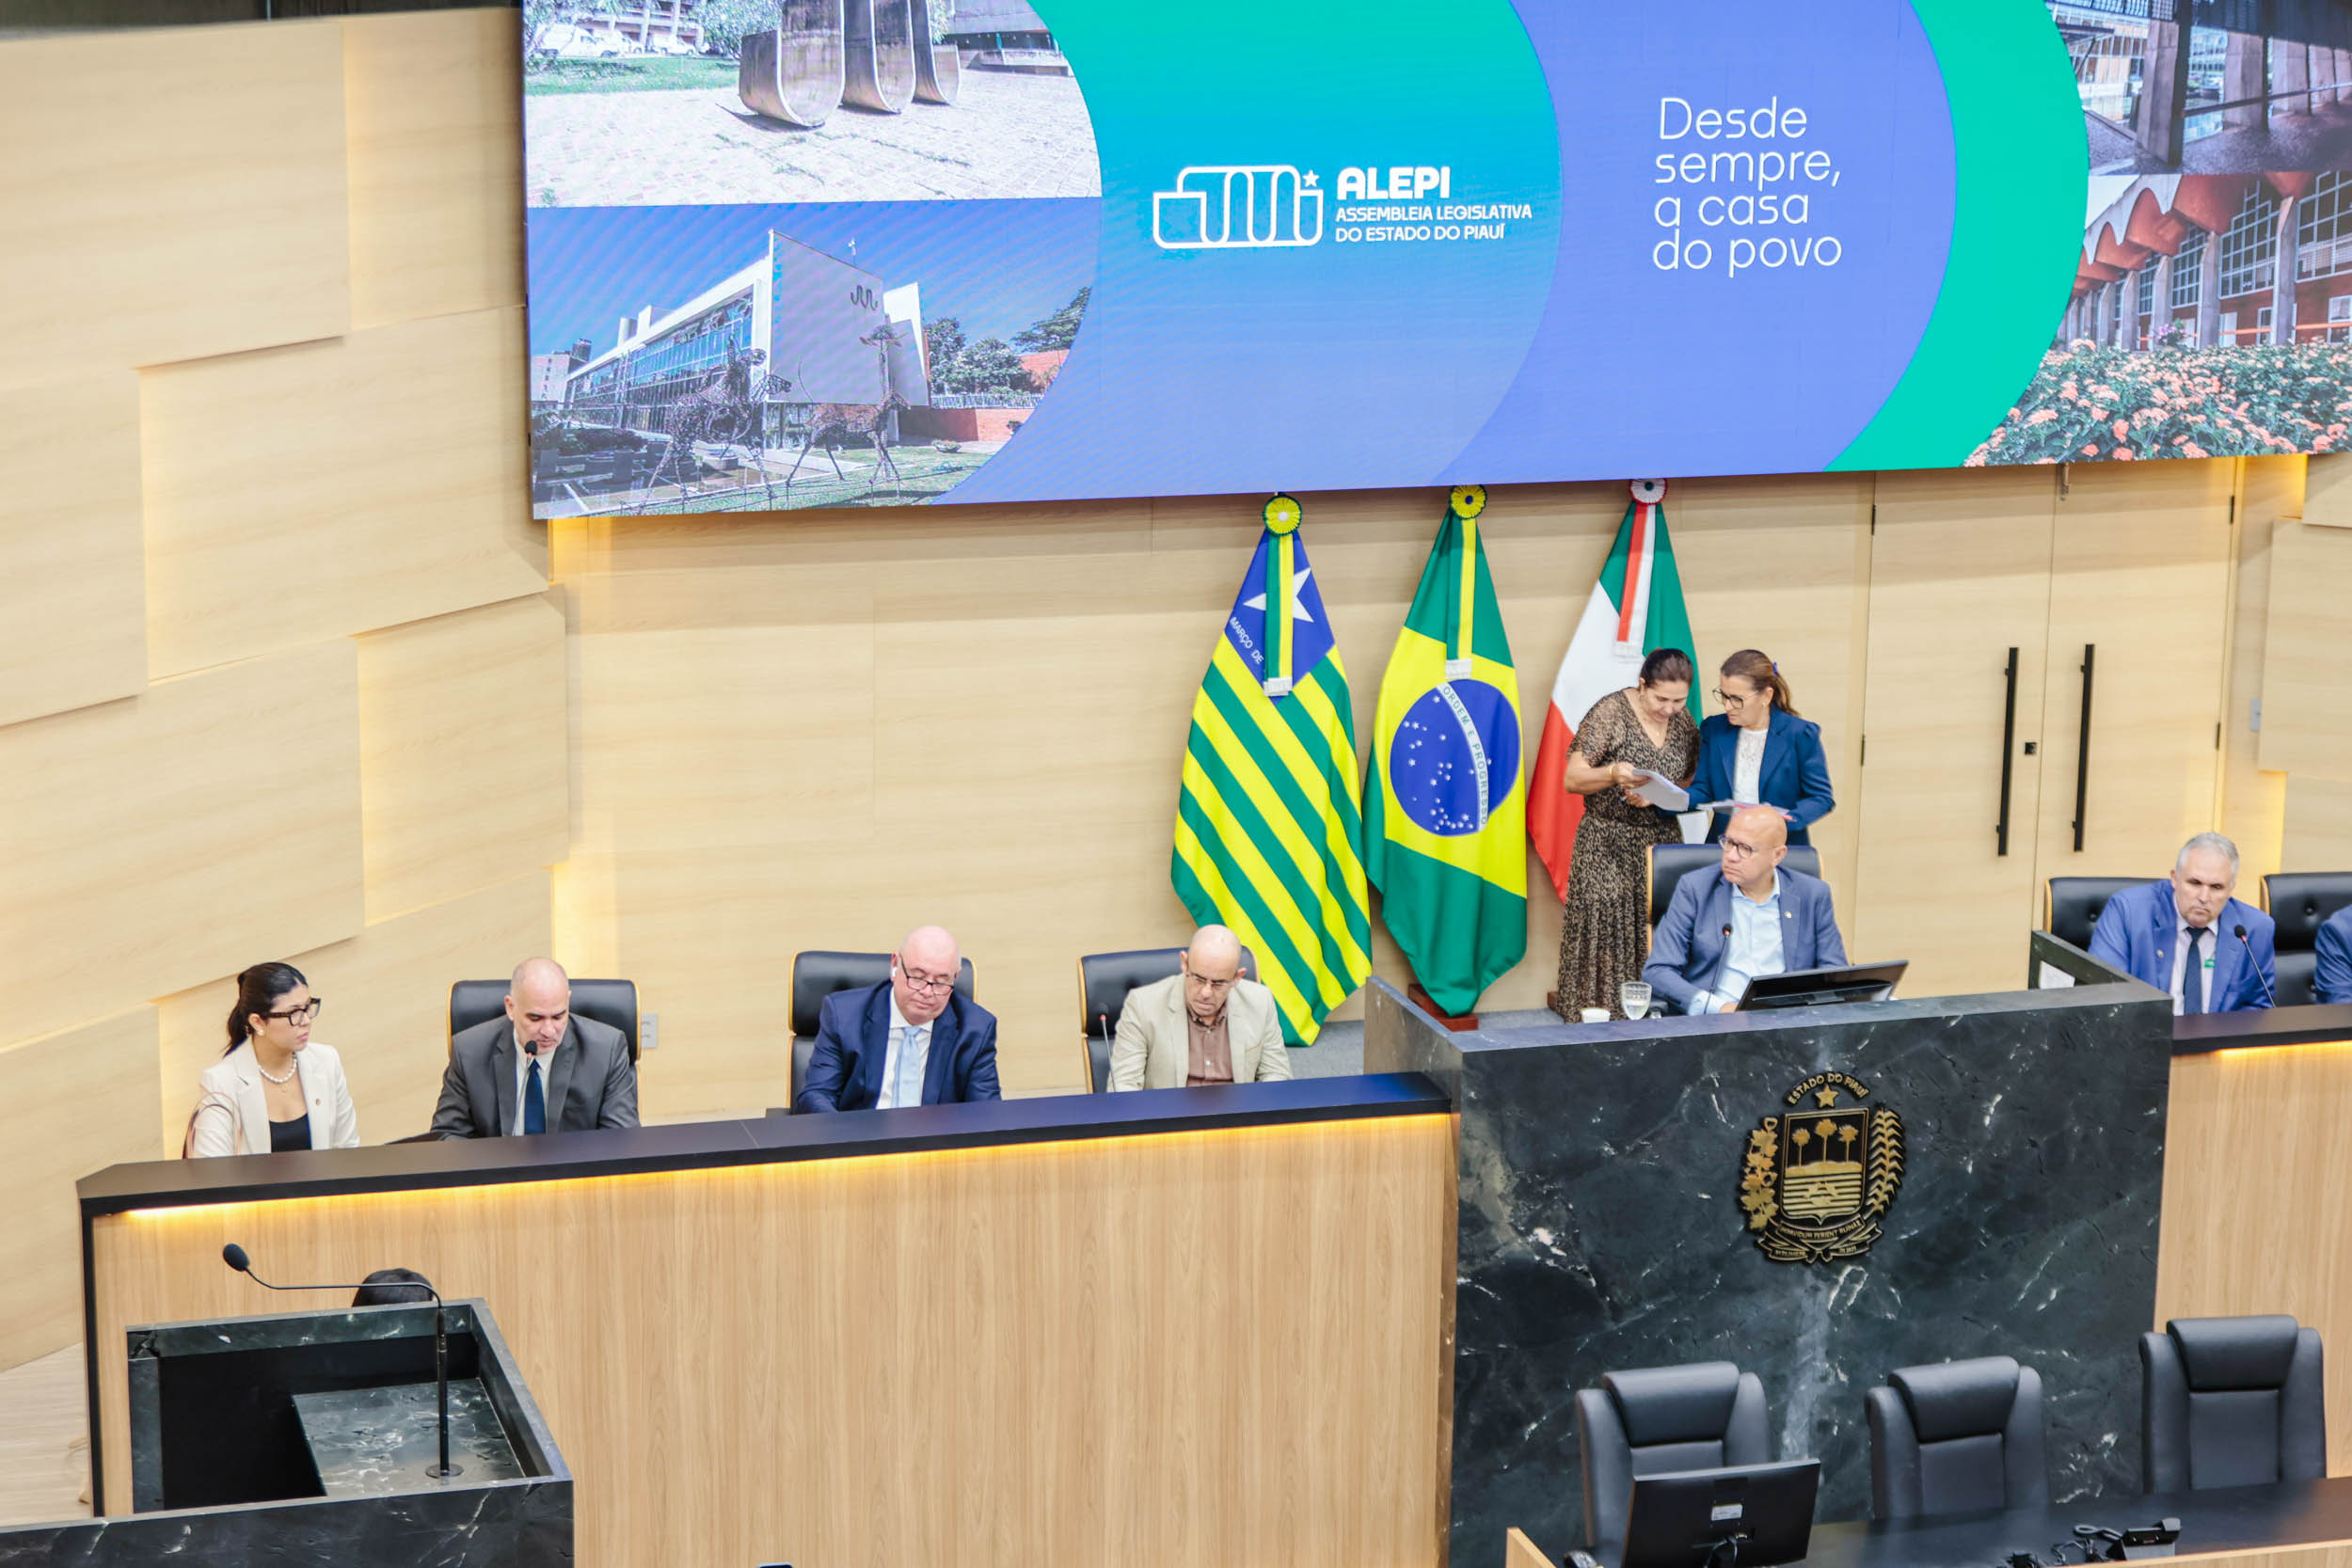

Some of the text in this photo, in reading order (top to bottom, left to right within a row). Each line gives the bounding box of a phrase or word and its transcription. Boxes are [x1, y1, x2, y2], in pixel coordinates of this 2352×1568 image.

[1660, 96, 1807, 139] Desde
[1336, 166, 1451, 200] ALEPI
[1655, 150, 1840, 192] sempre,
[1335, 203, 1533, 222] ASSEMBLEIA LEGISLATIVA
[1654, 194, 1809, 227] a casa
[1335, 222, 1505, 242] DO ESTADO DO PIAUÍ
[1652, 229, 1843, 278] do povo
[1229, 616, 1264, 665] MARÇO DE
[1442, 686, 1488, 825] ORDEM E PROGRESSO
[1787, 1074, 1825, 1105] ESTADO
[1827, 1072, 1844, 1084] DO
